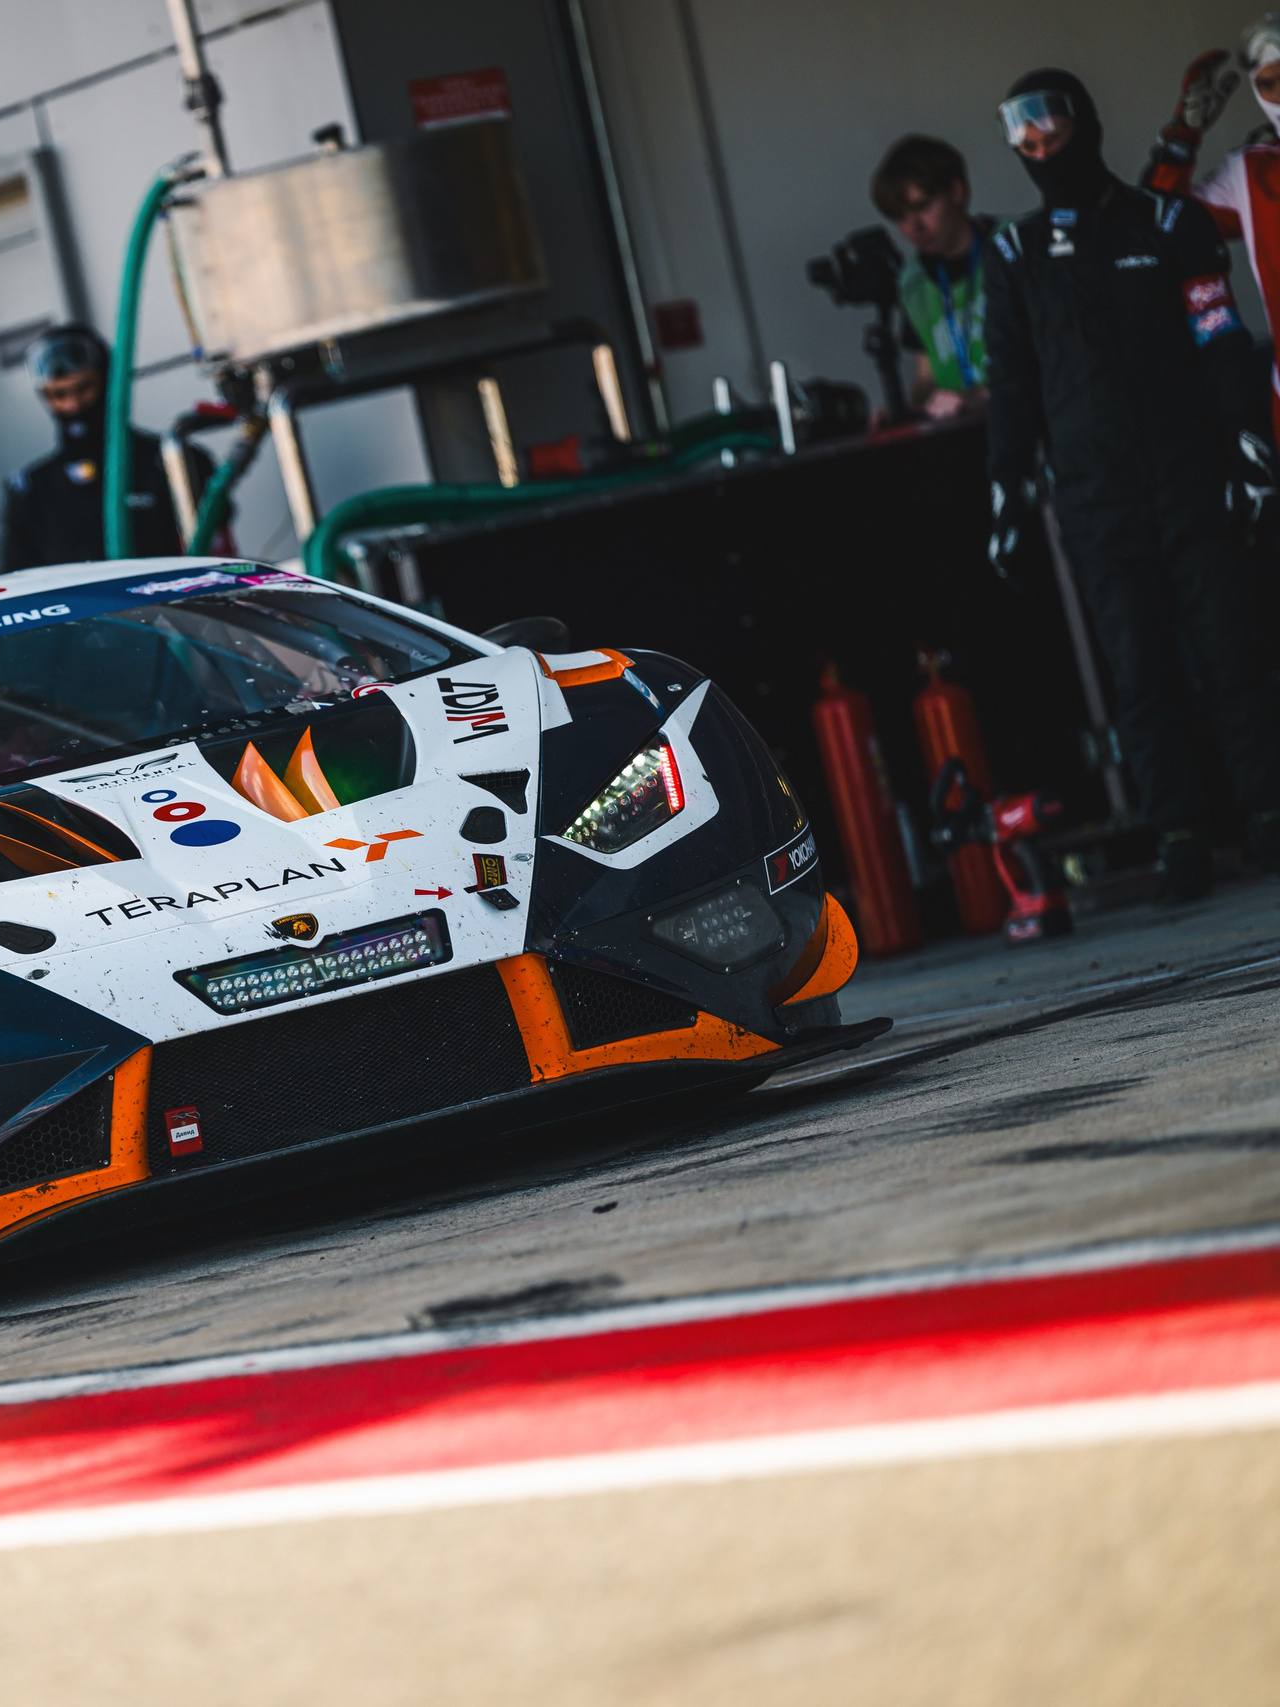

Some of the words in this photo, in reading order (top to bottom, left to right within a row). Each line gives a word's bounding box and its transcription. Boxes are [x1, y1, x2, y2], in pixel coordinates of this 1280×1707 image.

[74, 761, 197, 793] CONTINENTAL
[788, 832, 816, 870] YOKOH
[485, 857, 498, 886] OMP
[85, 857, 347, 926] TERAPLAN
